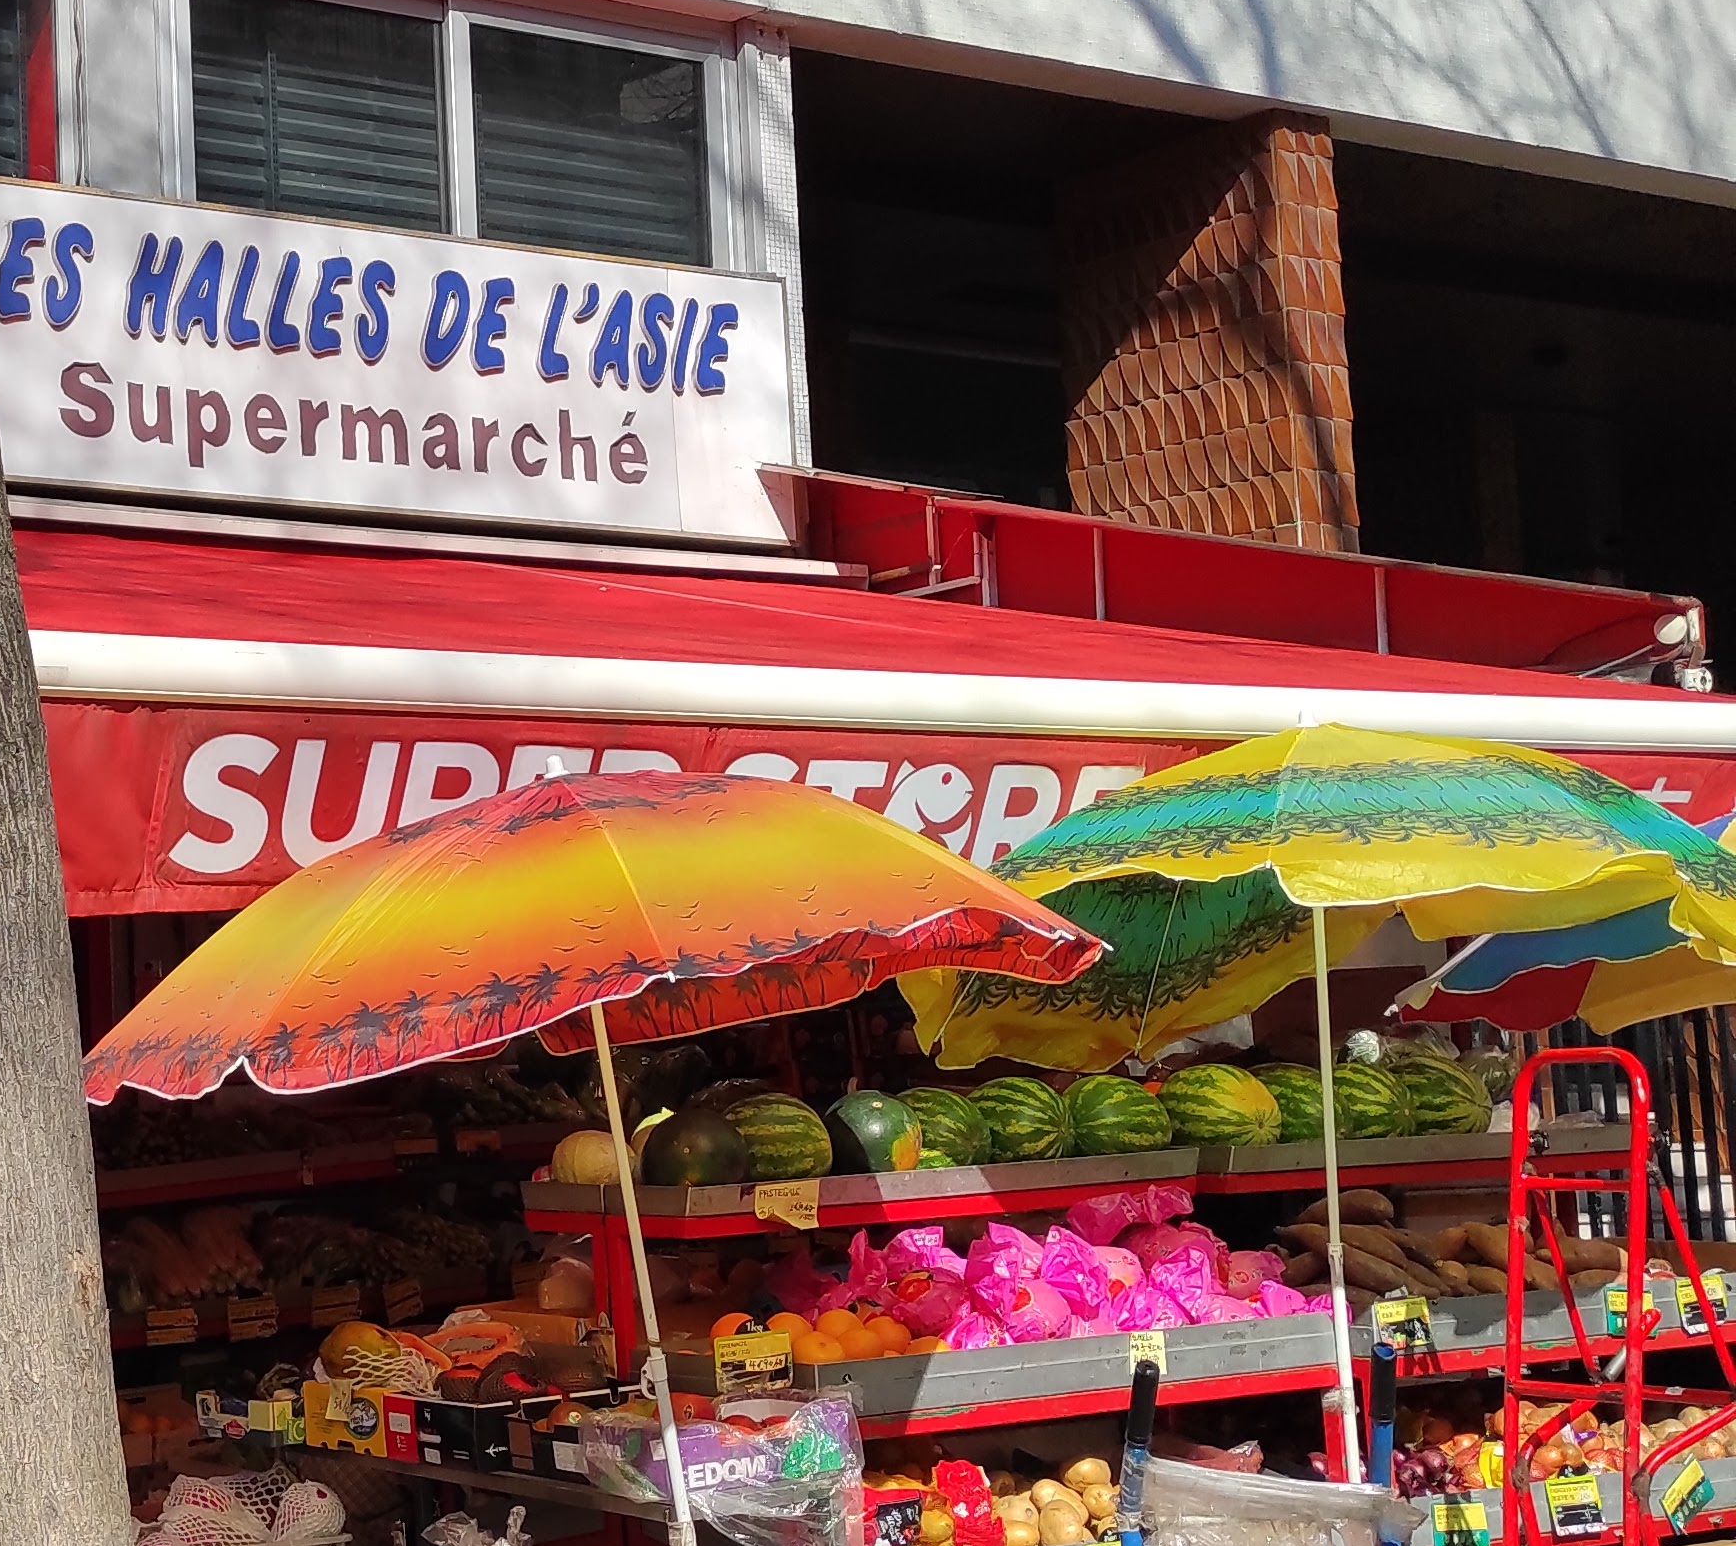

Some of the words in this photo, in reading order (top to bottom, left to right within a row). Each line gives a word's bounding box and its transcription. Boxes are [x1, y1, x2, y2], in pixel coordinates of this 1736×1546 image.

[122, 231, 397, 366] HALLES
[420, 269, 516, 377] DE
[536, 282, 739, 397] L'ASIE
[58, 360, 649, 485] Supermarché
[167, 732, 682, 875] SUP
[687, 1454, 766, 1489] EDOM
